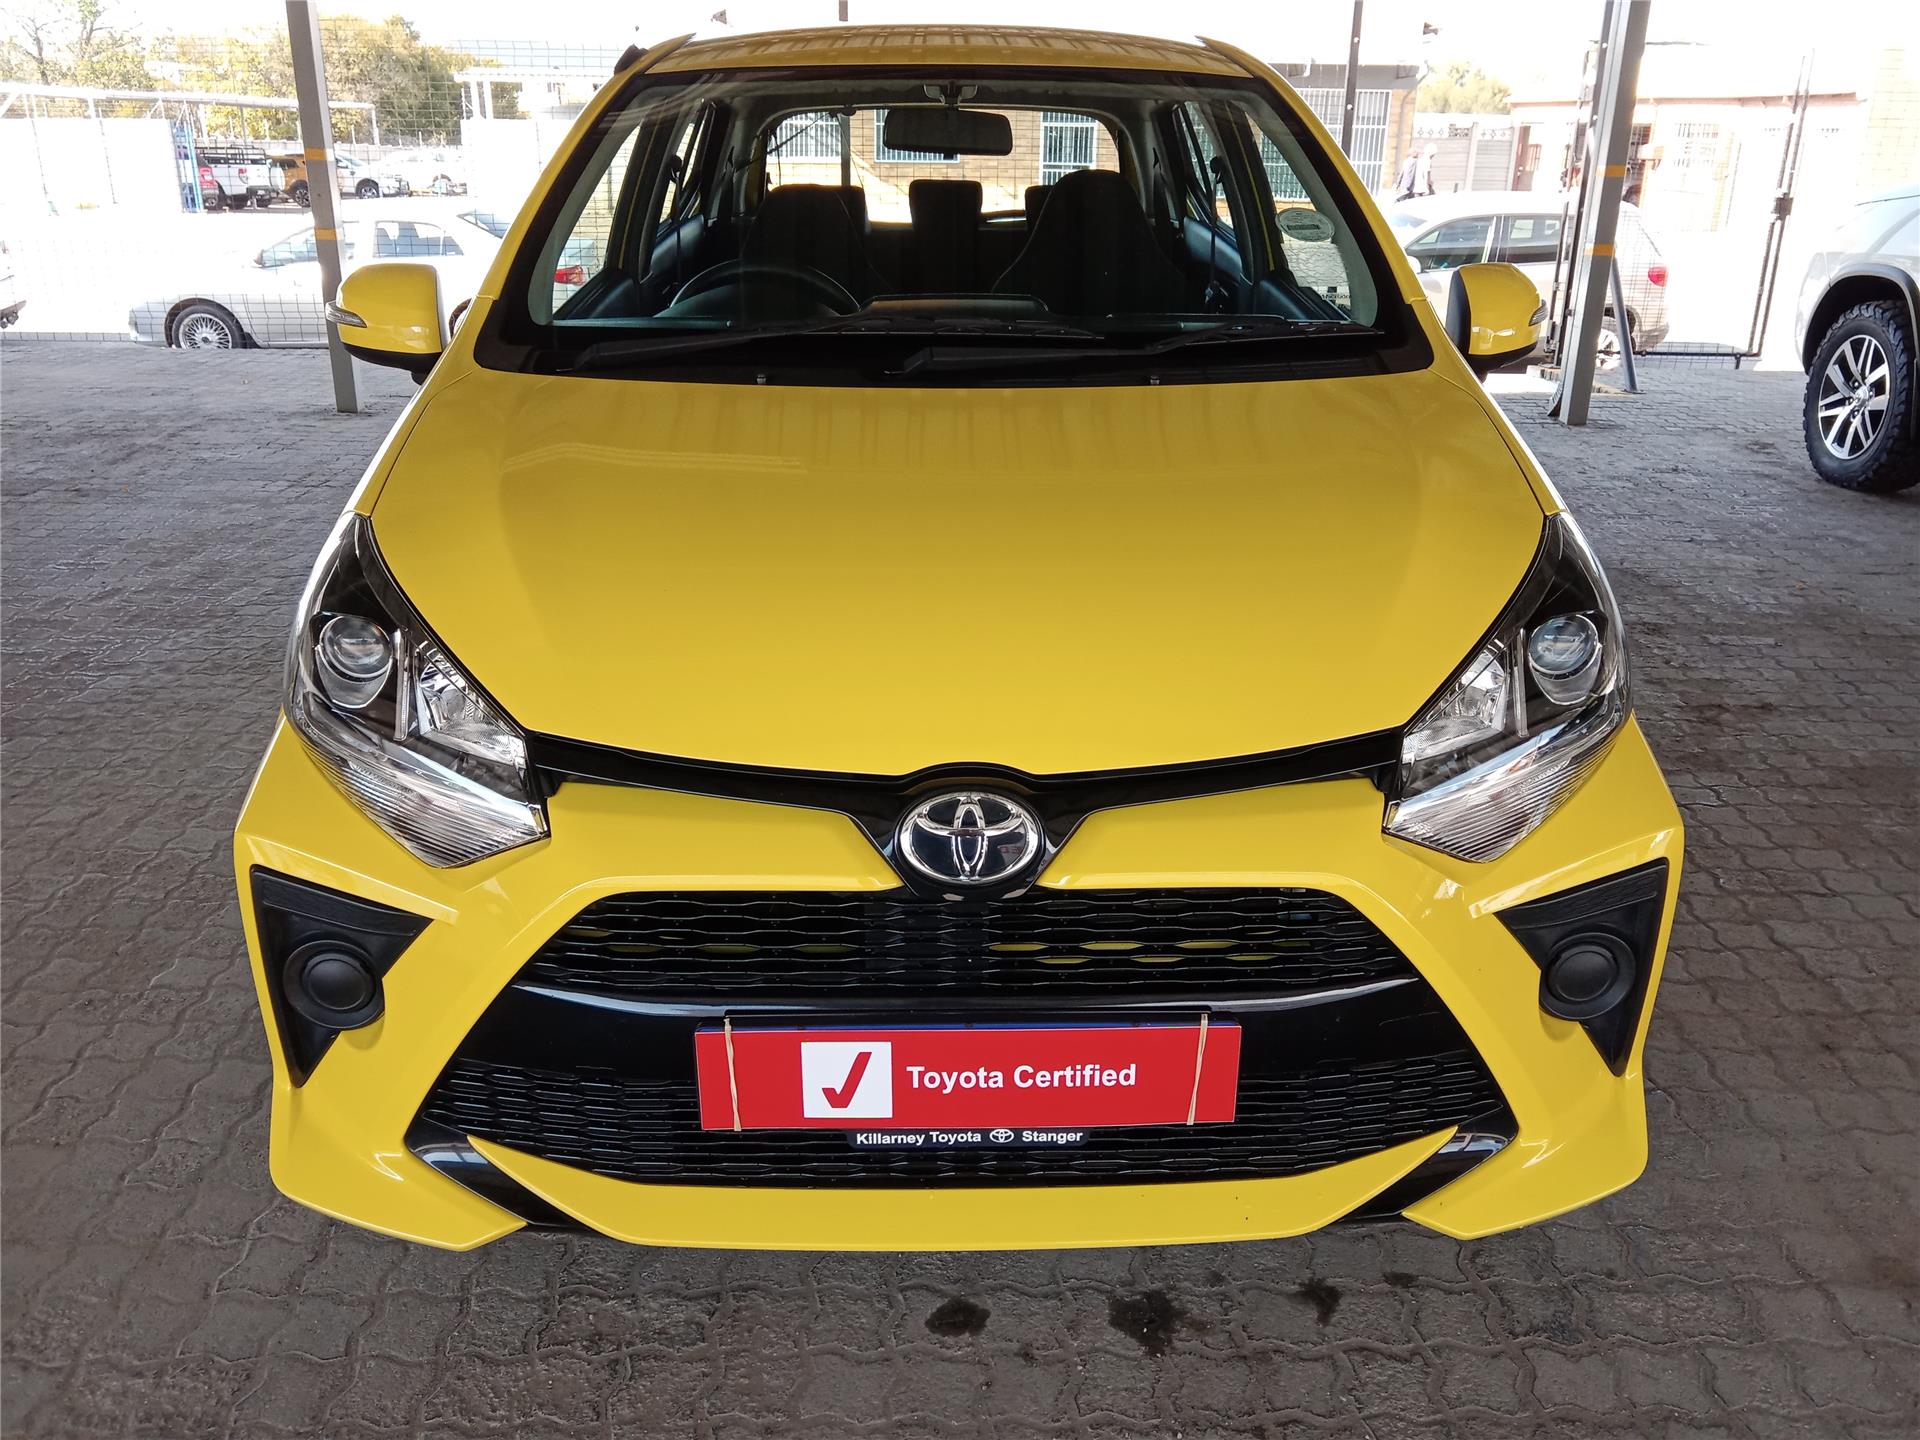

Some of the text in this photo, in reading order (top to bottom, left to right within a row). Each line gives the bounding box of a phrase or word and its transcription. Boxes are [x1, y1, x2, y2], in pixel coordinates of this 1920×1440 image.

[906, 1063, 1137, 1095] Toyota Certified
[856, 1130, 1084, 1146] Killarney Toyota Stanger
